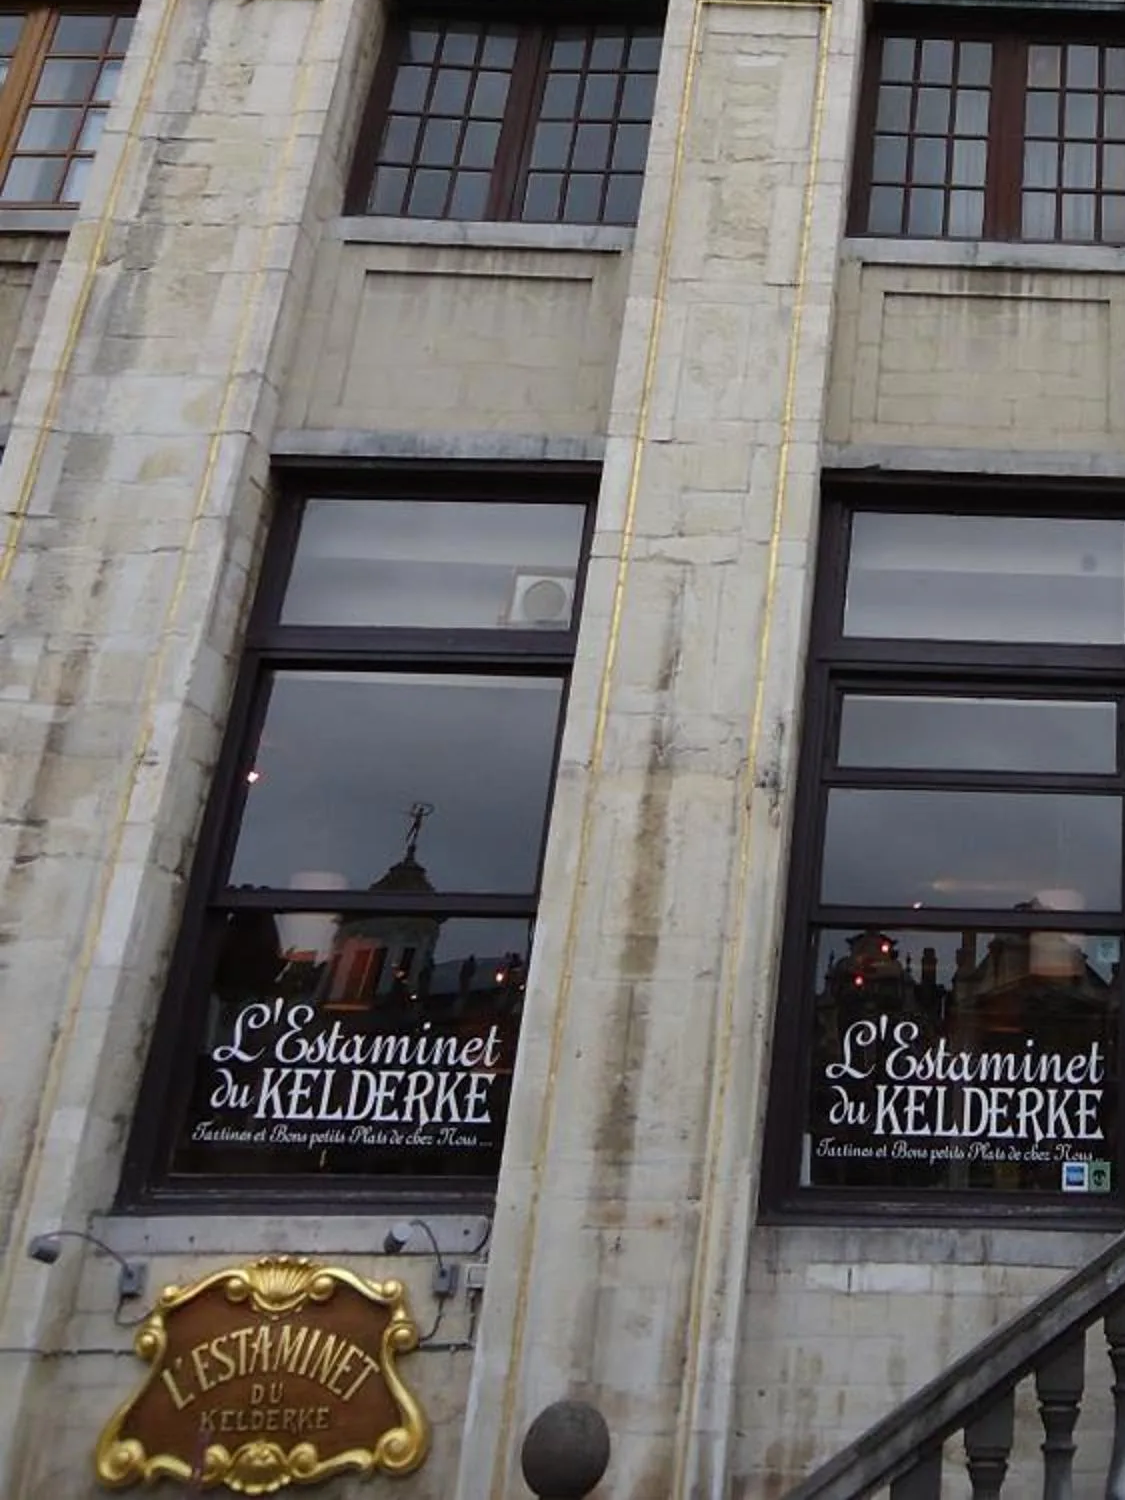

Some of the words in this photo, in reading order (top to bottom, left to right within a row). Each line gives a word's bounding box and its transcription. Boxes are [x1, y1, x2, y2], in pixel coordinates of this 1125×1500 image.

[212, 998, 503, 1067] L'Estaminet
[825, 1014, 1105, 1084] L'Estaminet
[210, 1069, 252, 1109] du
[254, 1068, 497, 1126] KELDERKE
[829, 1085, 872, 1125] du
[873, 1085, 1105, 1143] KELDERKE
[253, 1127, 266, 1142] et
[350, 1125, 387, 1144] Plats
[389, 1129, 403, 1145] de
[405, 1127, 433, 1145] chez
[875, 1144, 888, 1158] et
[967, 1141, 1006, 1160] Plats
[162, 1324, 380, 1411] L'ESTAMINET
[250, 1380, 285, 1404] DU
[200, 1407, 330, 1435] KELDERKE
